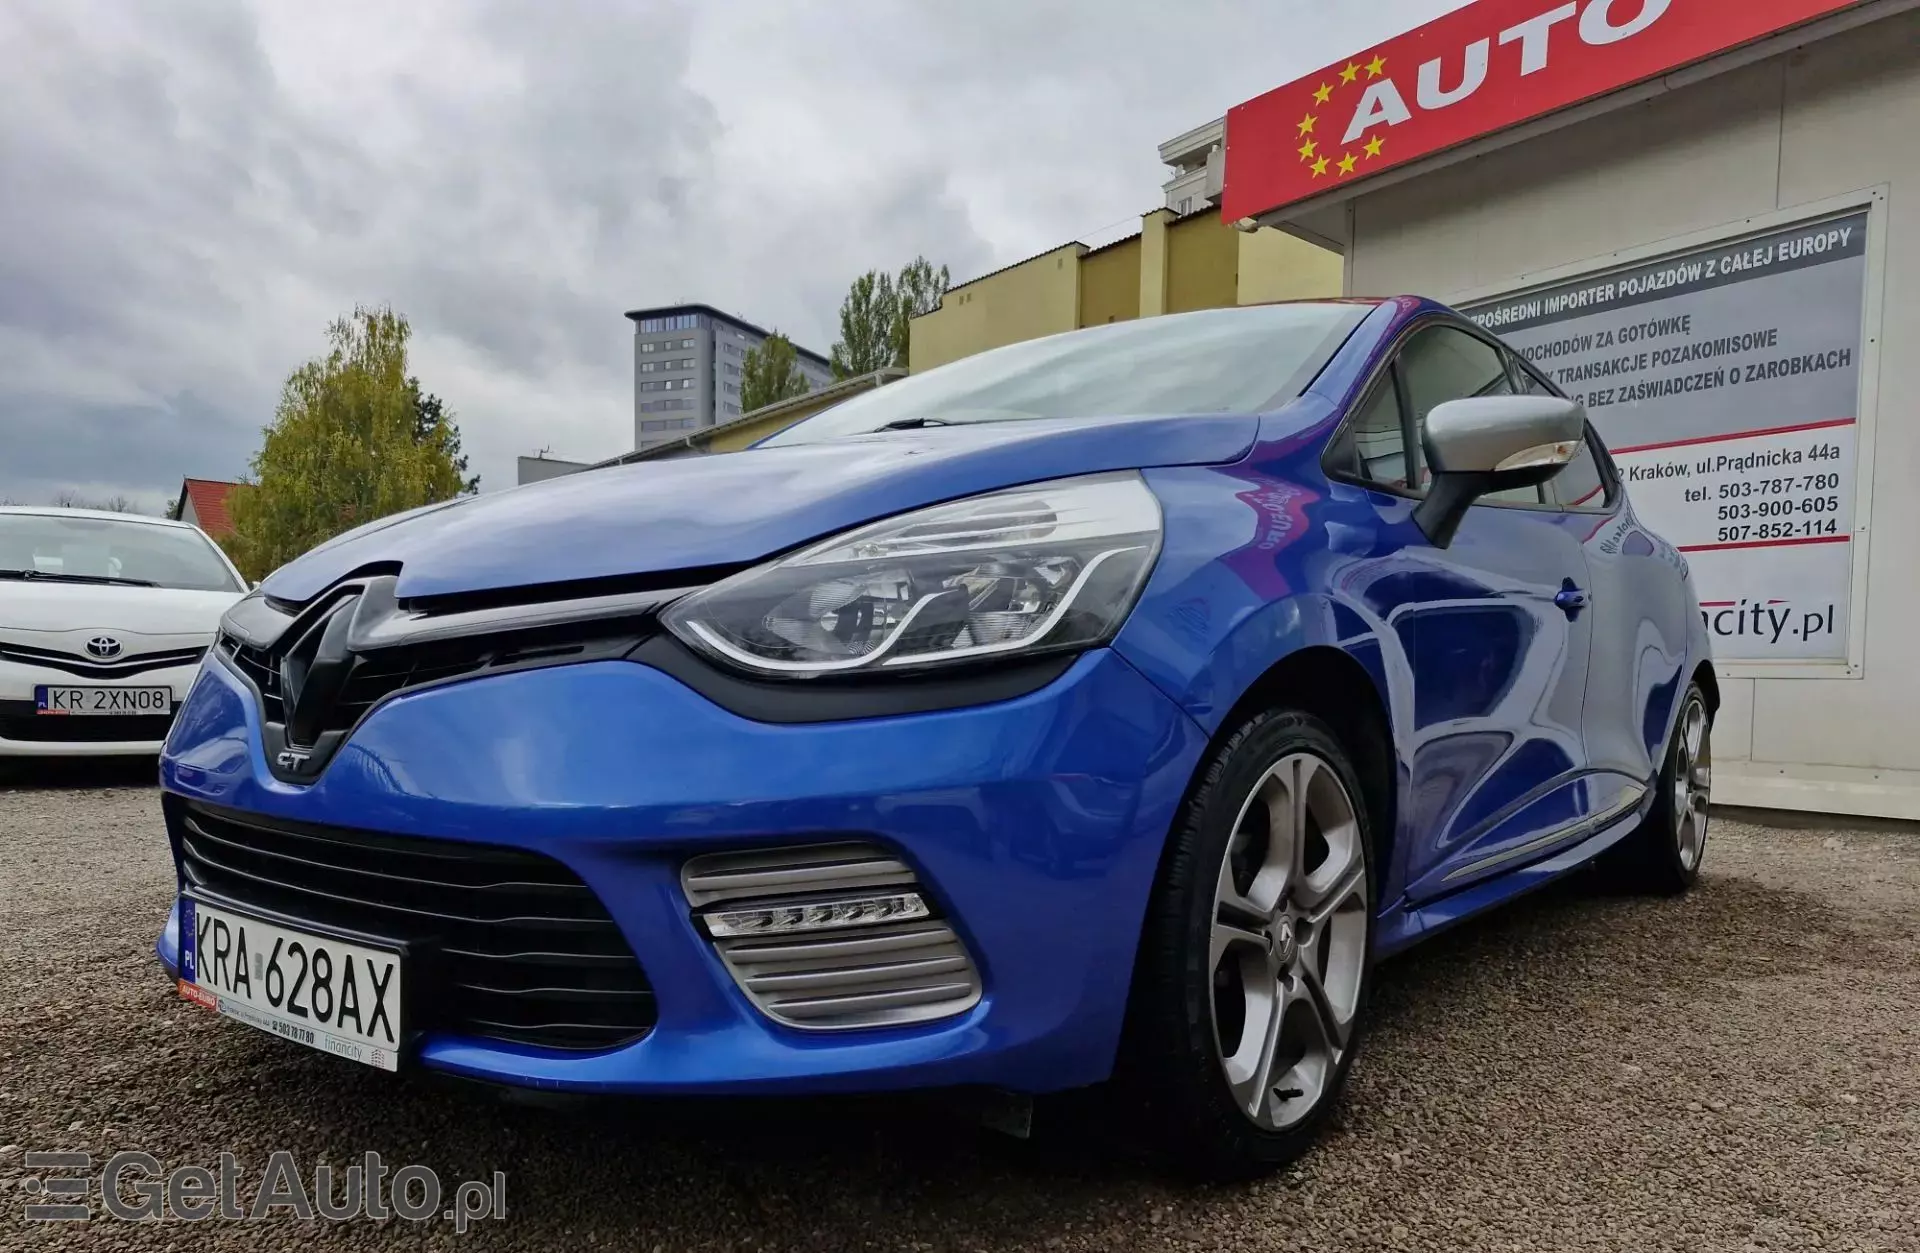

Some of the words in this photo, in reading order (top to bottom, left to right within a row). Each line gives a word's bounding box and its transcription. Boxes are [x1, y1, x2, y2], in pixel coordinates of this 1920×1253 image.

[1341, 0, 1671, 145] AUTO
[1544, 284, 1615, 315] IMPORTER
[1618, 262, 1703, 298] POJAZDÓW
[1705, 260, 1716, 278] Z
[1720, 244, 1773, 275] CAŁEJ
[1778, 227, 1852, 262] EUROPY
[1596, 331, 1614, 349] ZA
[1618, 314, 1691, 344] GOTÓWKĘ
[1558, 354, 1648, 384] TRANSAKCJE
[1652, 328, 1778, 370] POZAKOMISOWE
[1588, 387, 1615, 408] BEZ
[1618, 365, 1725, 403] ZAŚWIADCZEŃ
[1729, 365, 1741, 385] O
[1745, 348, 1852, 383] ZAROBKACH
[1629, 461, 1691, 481] Kraków,
[1696, 447, 1802, 475] ul.Prądnicka
[1808, 443, 1840, 461] 44a
[1685, 486, 1711, 502] tel.
[1718, 472, 1839, 500] 503-787-780
[1717, 496, 1839, 521] 503-900-605
[1717, 519, 1837, 542] 507-852-114
[53, 690, 83, 709] KR
[94, 690, 164, 709] 2XN08
[277, 752, 310, 771] GT
[184, 949, 195, 970] PL
[196, 912, 252, 999] KRA
[265, 937, 396, 1044] 628AX
